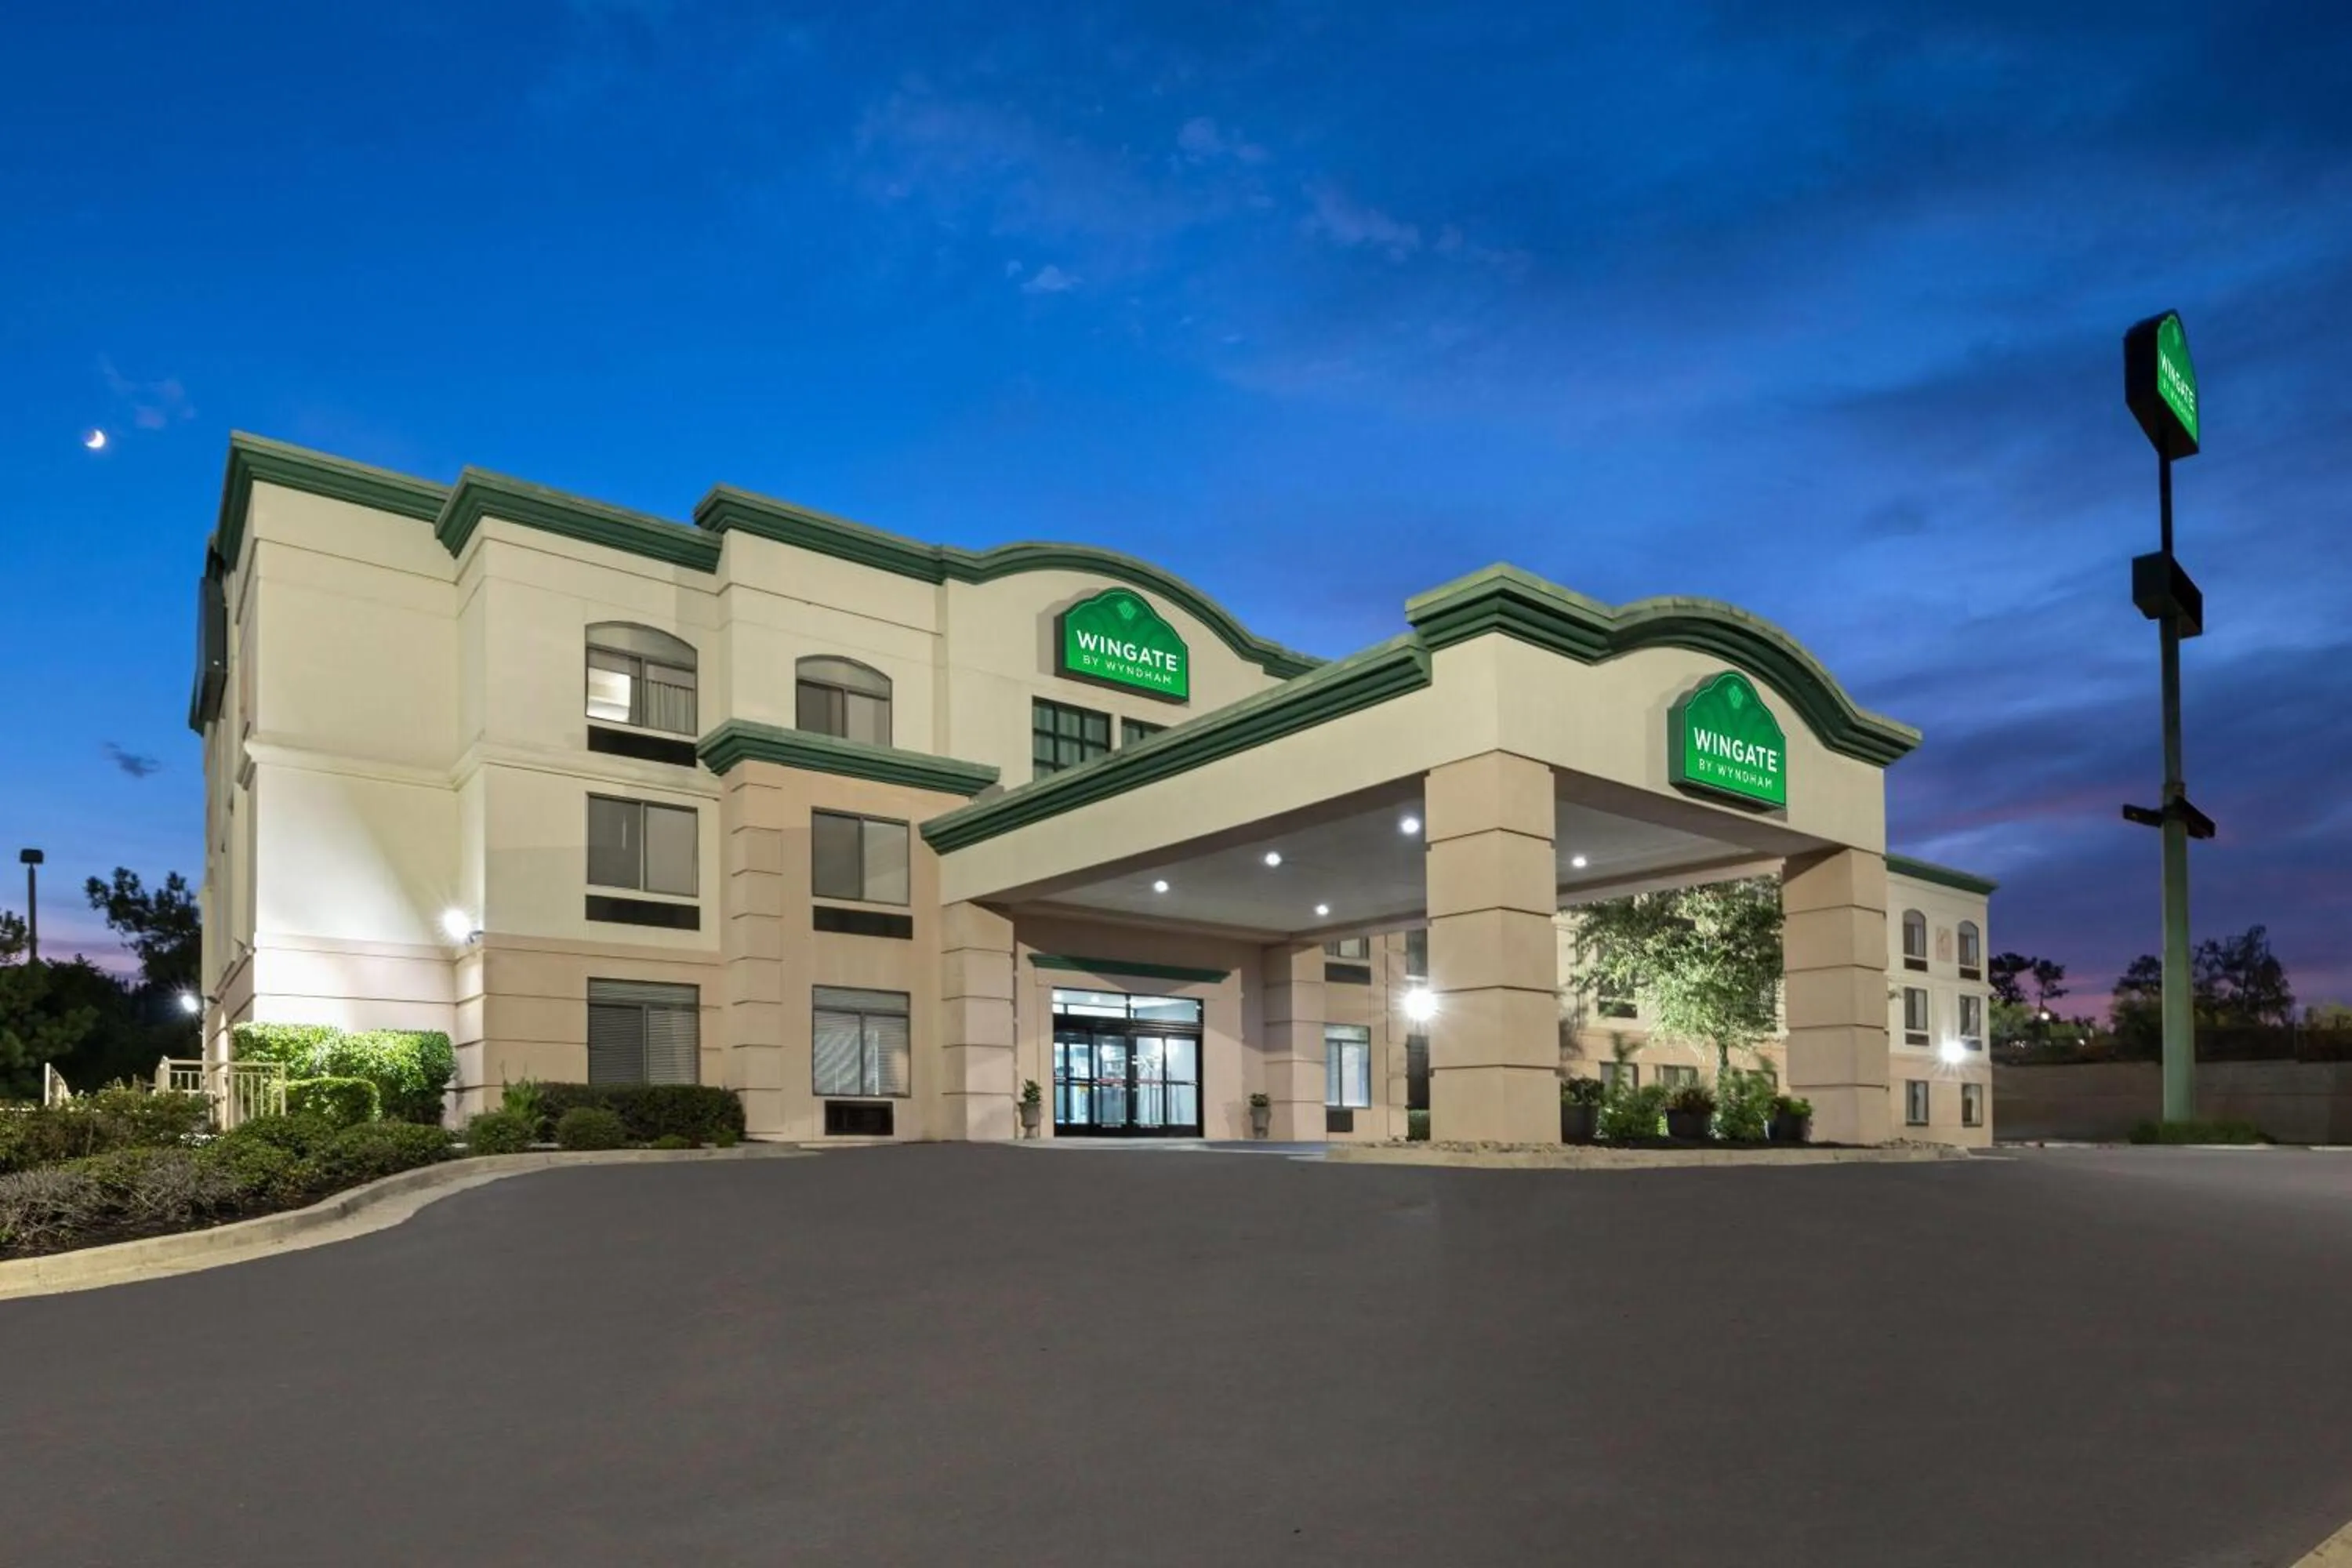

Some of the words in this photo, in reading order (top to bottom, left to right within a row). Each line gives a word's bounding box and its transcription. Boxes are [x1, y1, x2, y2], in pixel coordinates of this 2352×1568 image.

[1076, 630, 1178, 672] WINGATE
[1083, 655, 1098, 666] BY
[1105, 661, 1172, 684] WYNDHAM
[1693, 727, 1777, 773] WINGATE
[1699, 758, 1712, 771] BY
[1717, 764, 1772, 789] WYNDHAM
